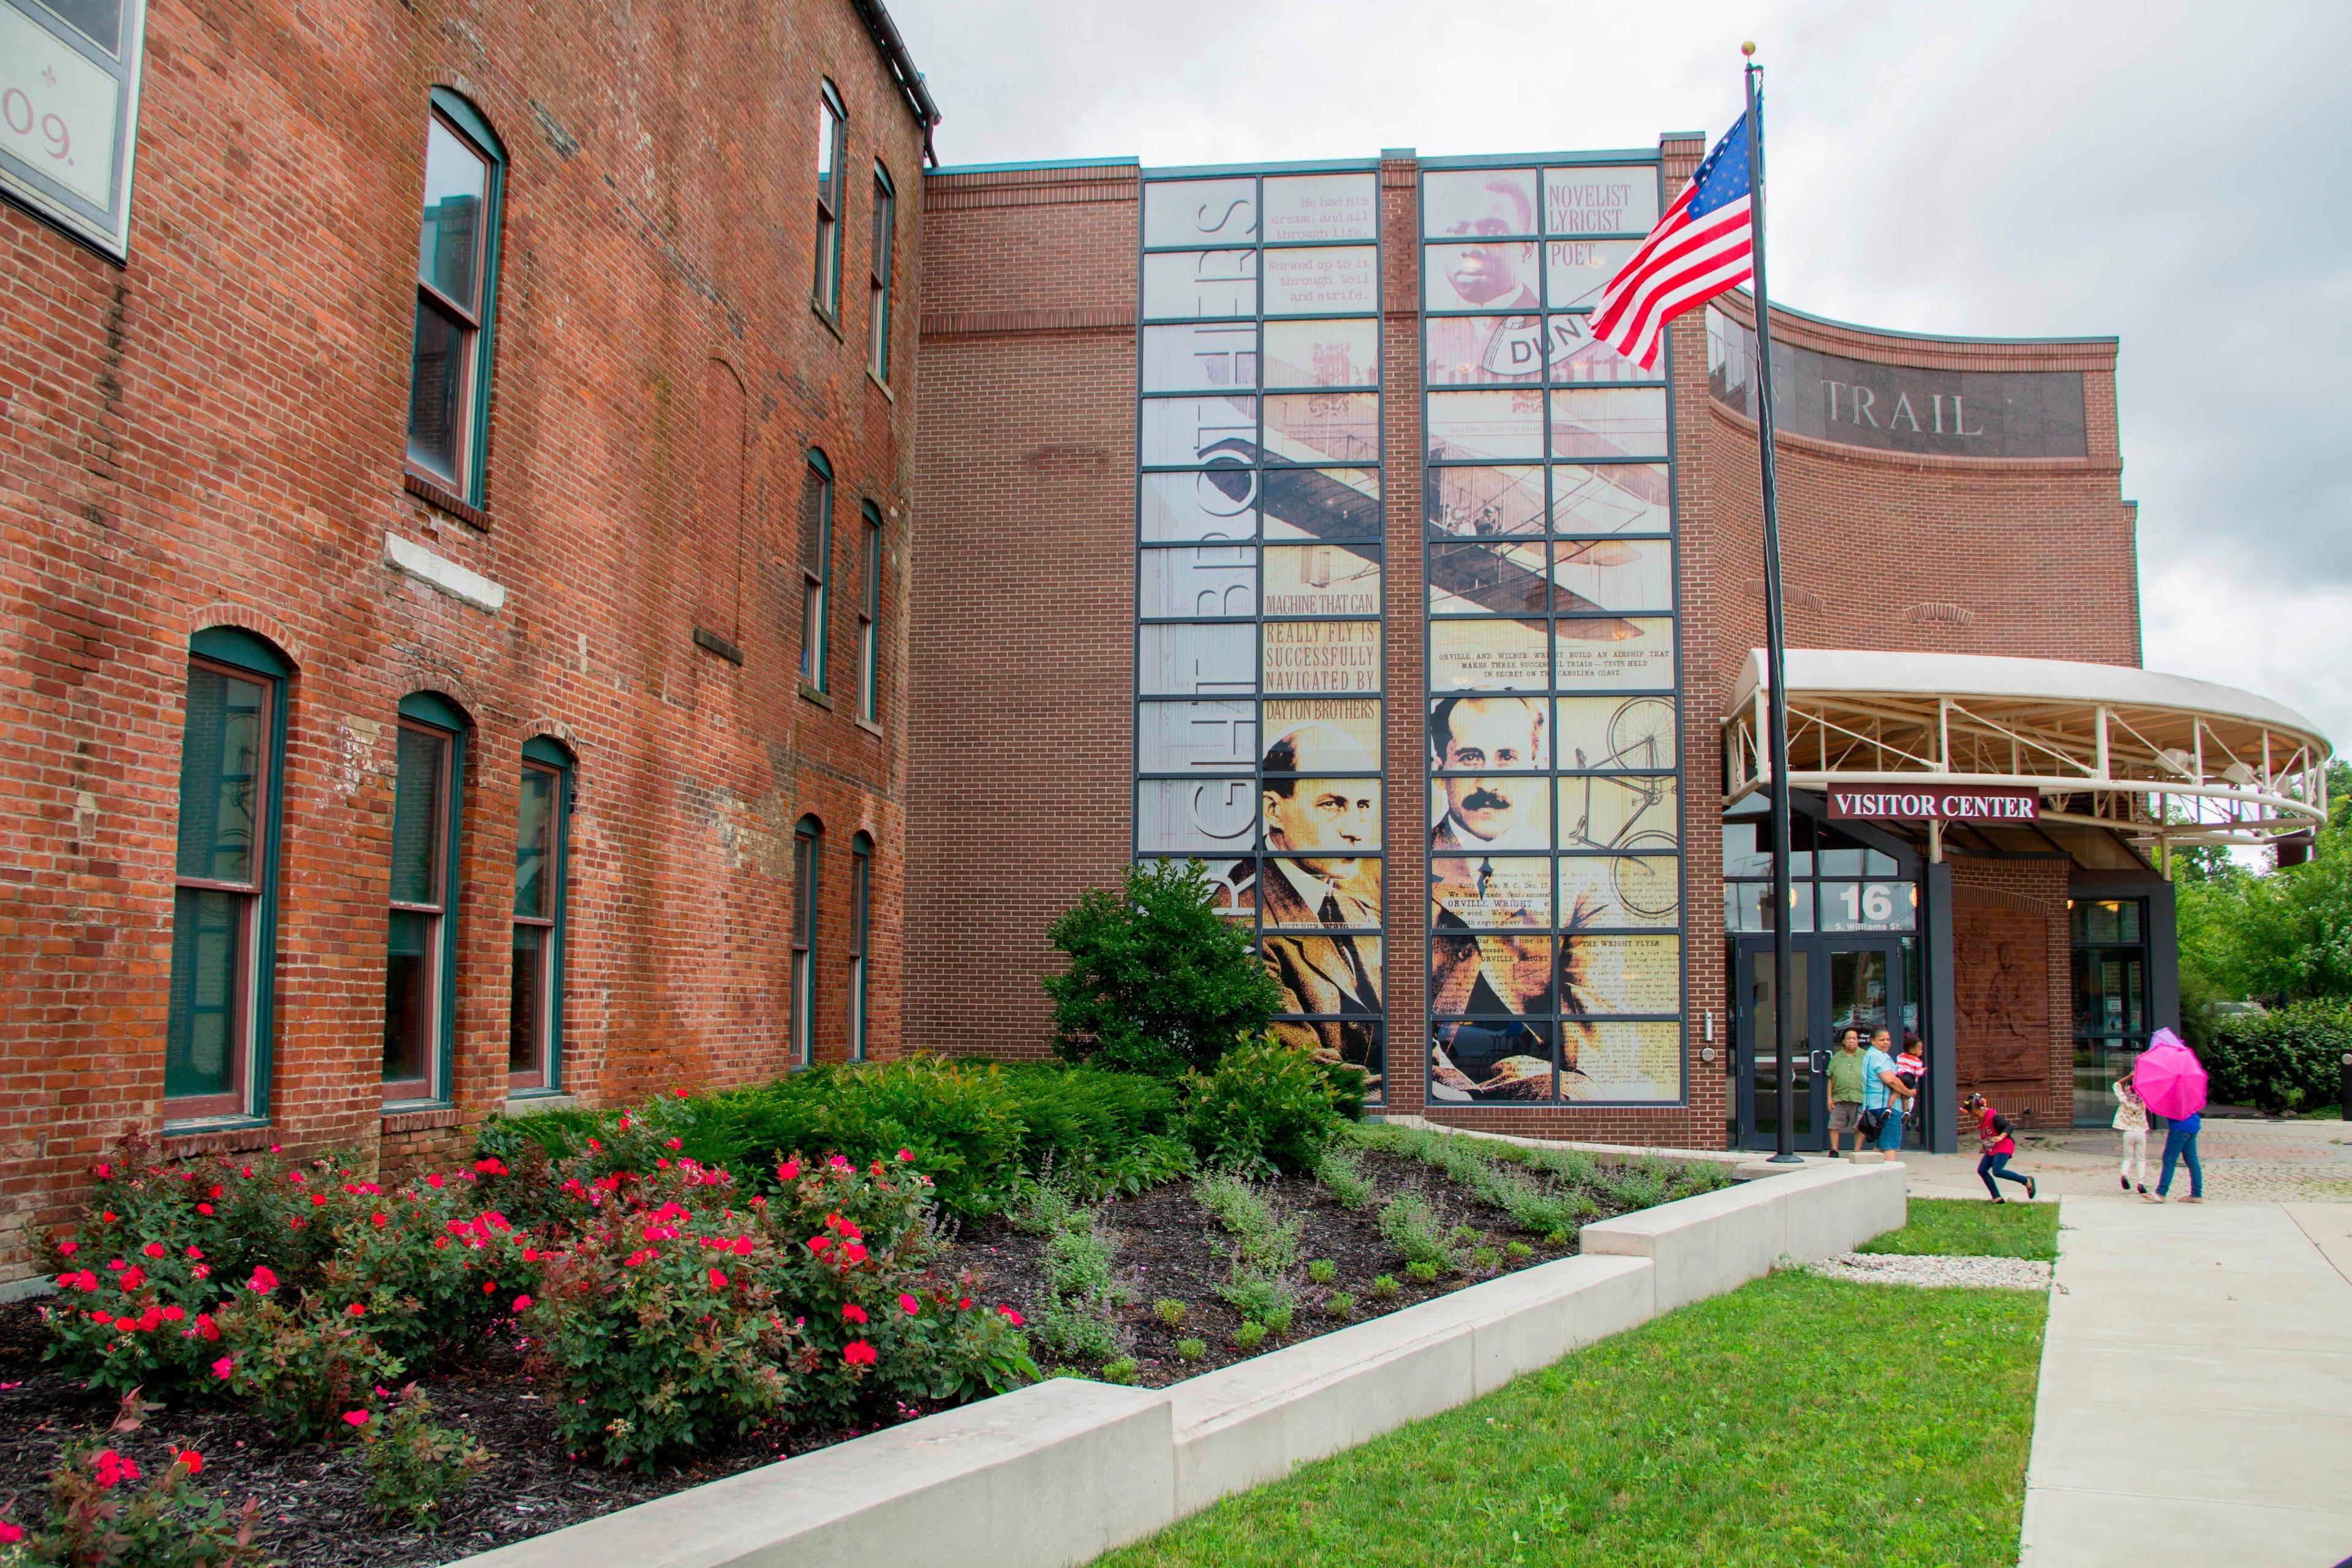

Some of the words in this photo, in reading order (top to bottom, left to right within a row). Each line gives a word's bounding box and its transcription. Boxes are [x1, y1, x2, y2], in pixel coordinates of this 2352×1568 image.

[1301, 197, 1317, 208] He
[1319, 197, 1343, 207] had
[1346, 196, 1369, 207] his
[1548, 184, 1631, 208] NOVELIST
[1271, 213, 1315, 225] dream,
[1319, 212, 1343, 222] and
[1346, 211, 1368, 222] all
[1549, 209, 1623, 233] LYRICIST
[1276, 228, 1328, 240] through
[1332, 227, 1368, 239] life,
[1551, 243, 1596, 266] POET
[1267, 260, 1313, 270] Worked
[1317, 260, 1333, 272] up
[1337, 259, 1351, 269] to
[1355, 258, 1370, 268] it
[1280, 275, 1333, 287] through
[1341, 273, 1370, 284] toil
[1290, 291, 1314, 301] and
[1317, 290, 1368, 301] strife.
[1821, 379, 1985, 437] TRAIL
[1266, 595, 1316, 614] MACHINE
[1319, 594, 1348, 614] THAT
[1351, 594, 1373, 613] CAN
[1267, 623, 1321, 643] REALLY
[1329, 622, 1354, 643] FLY
[1361, 622, 1374, 642] IS
[1267, 647, 1374, 667] SUCCESSFULLY
[1266, 671, 1349, 691] NAVIGATED
[1357, 671, 1374, 690] BY
[1267, 700, 1311, 720] DAYTON
[1314, 701, 1374, 720] BROTHERS
[1834, 792, 1936, 816] VISITOR
[1942, 794, 2034, 818] CENTER
[1840, 884, 1892, 920] 16
